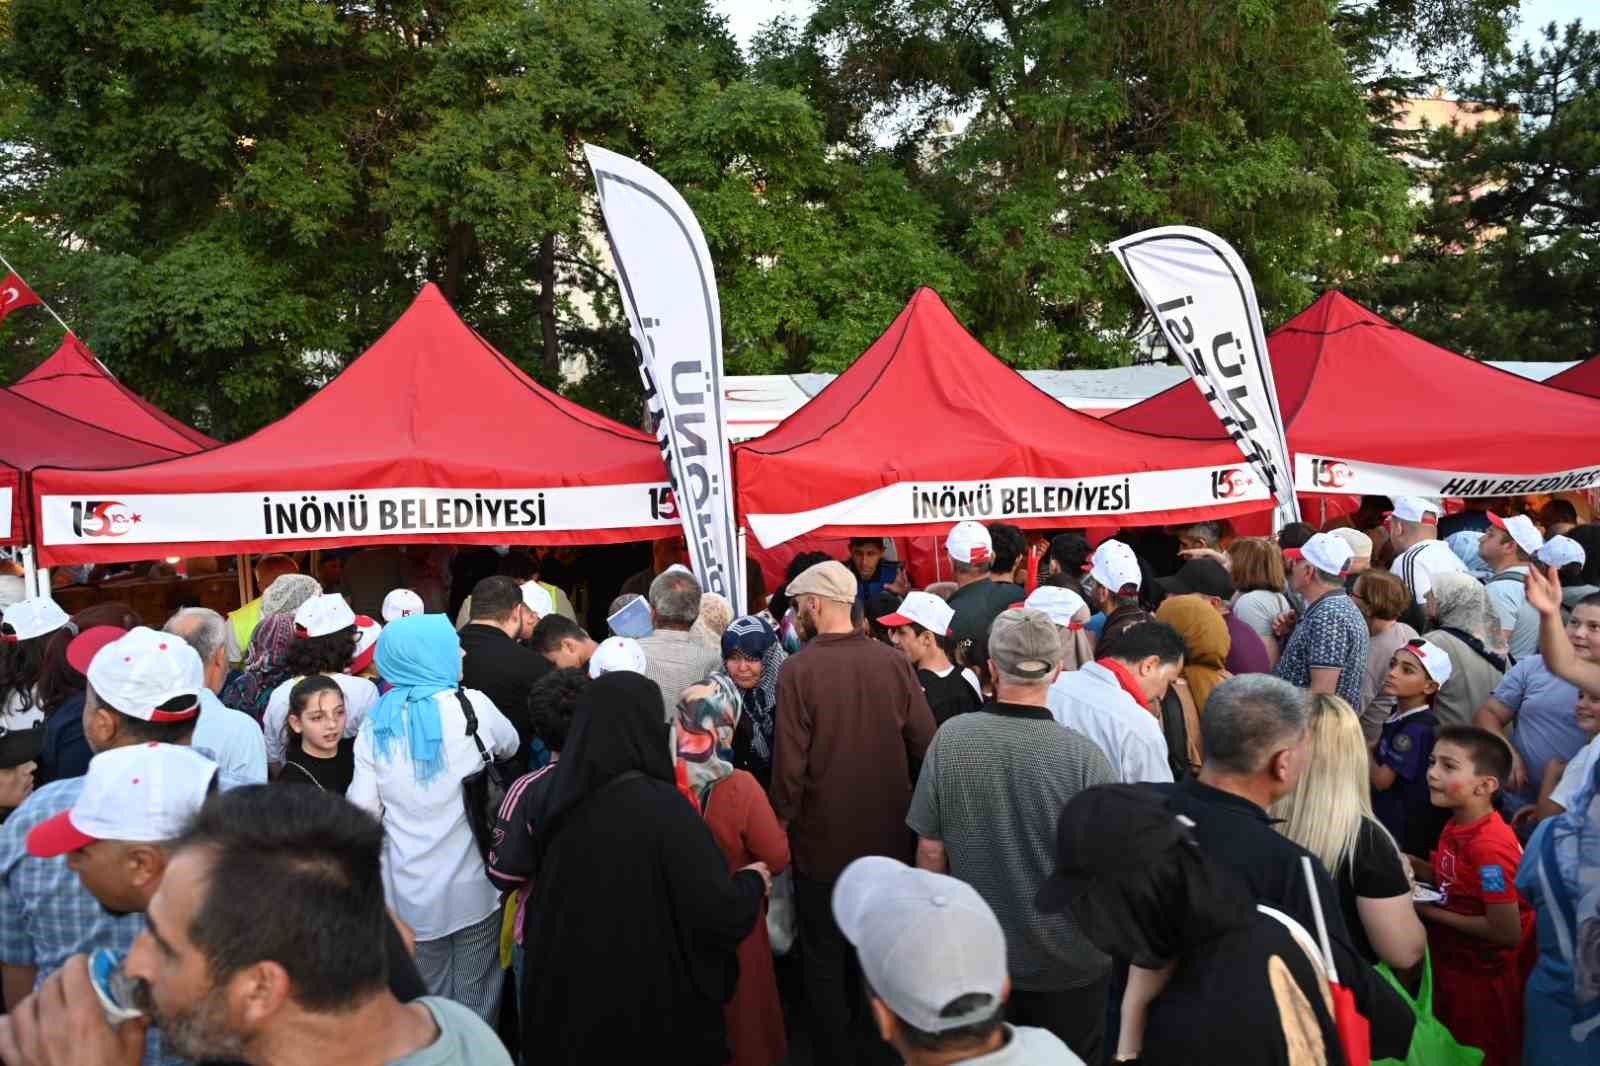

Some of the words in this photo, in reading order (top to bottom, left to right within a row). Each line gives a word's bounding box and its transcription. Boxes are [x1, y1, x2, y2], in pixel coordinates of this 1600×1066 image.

[913, 483, 993, 519] İNÖNÜ
[1000, 477, 1130, 514] BELEDİYESİ
[1439, 478, 1496, 496] HAN
[263, 494, 368, 535] İNÖNÜ
[379, 492, 546, 530] BELEDİYESİ
